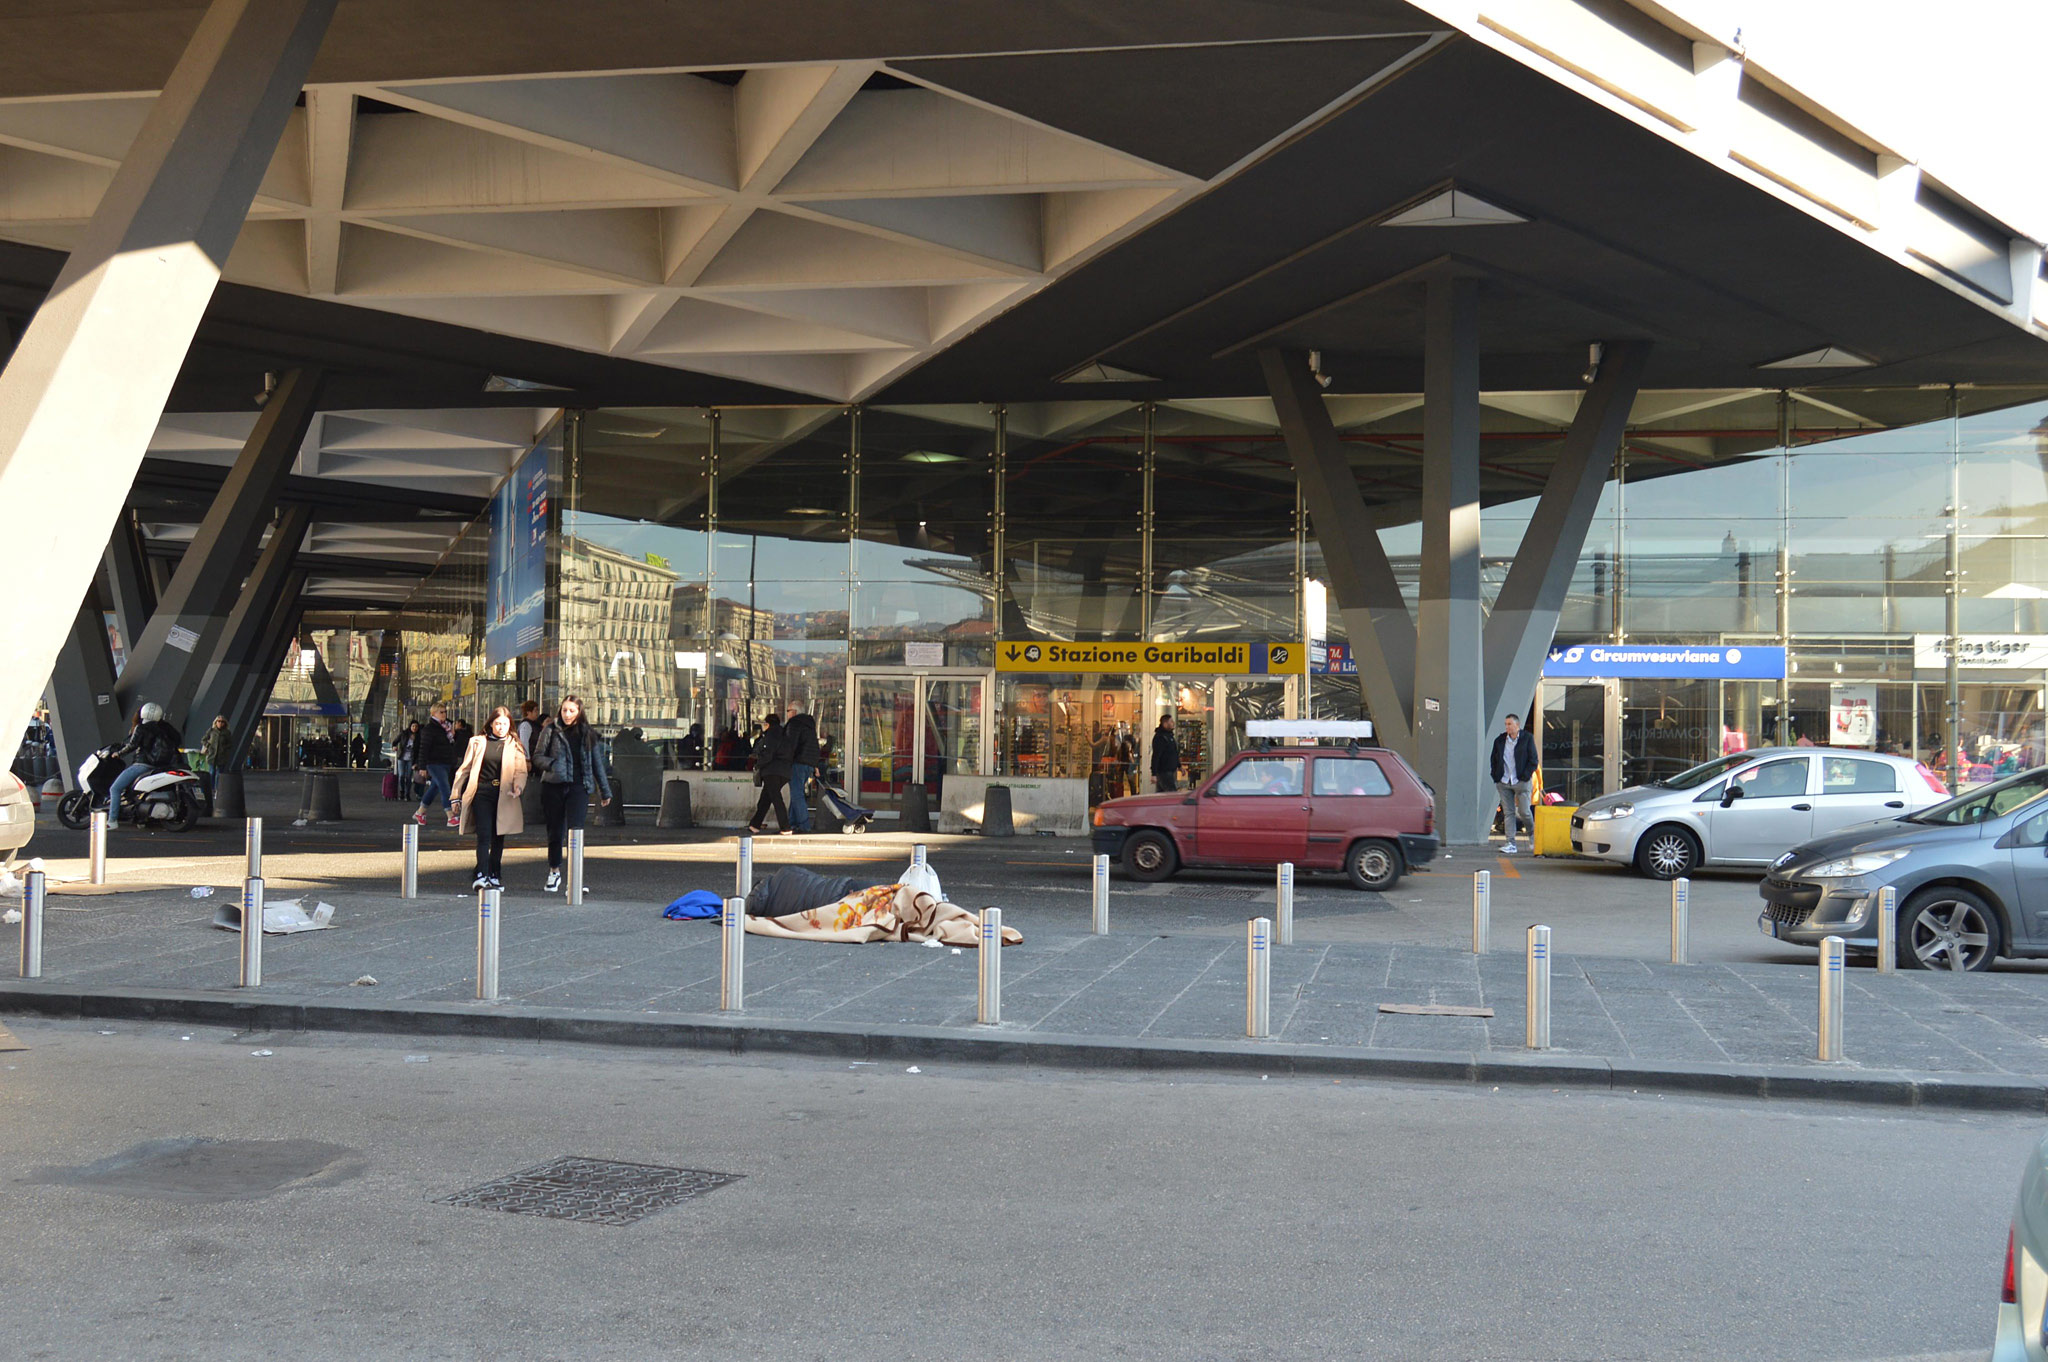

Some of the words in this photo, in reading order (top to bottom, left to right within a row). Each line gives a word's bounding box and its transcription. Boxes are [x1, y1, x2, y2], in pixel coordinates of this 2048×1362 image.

[1048, 645, 1138, 663] Stazione
[1144, 646, 1244, 664] Garibaldi
[1590, 649, 1720, 663] Circumvesuviana
[1985, 639, 2030, 656] tiger
